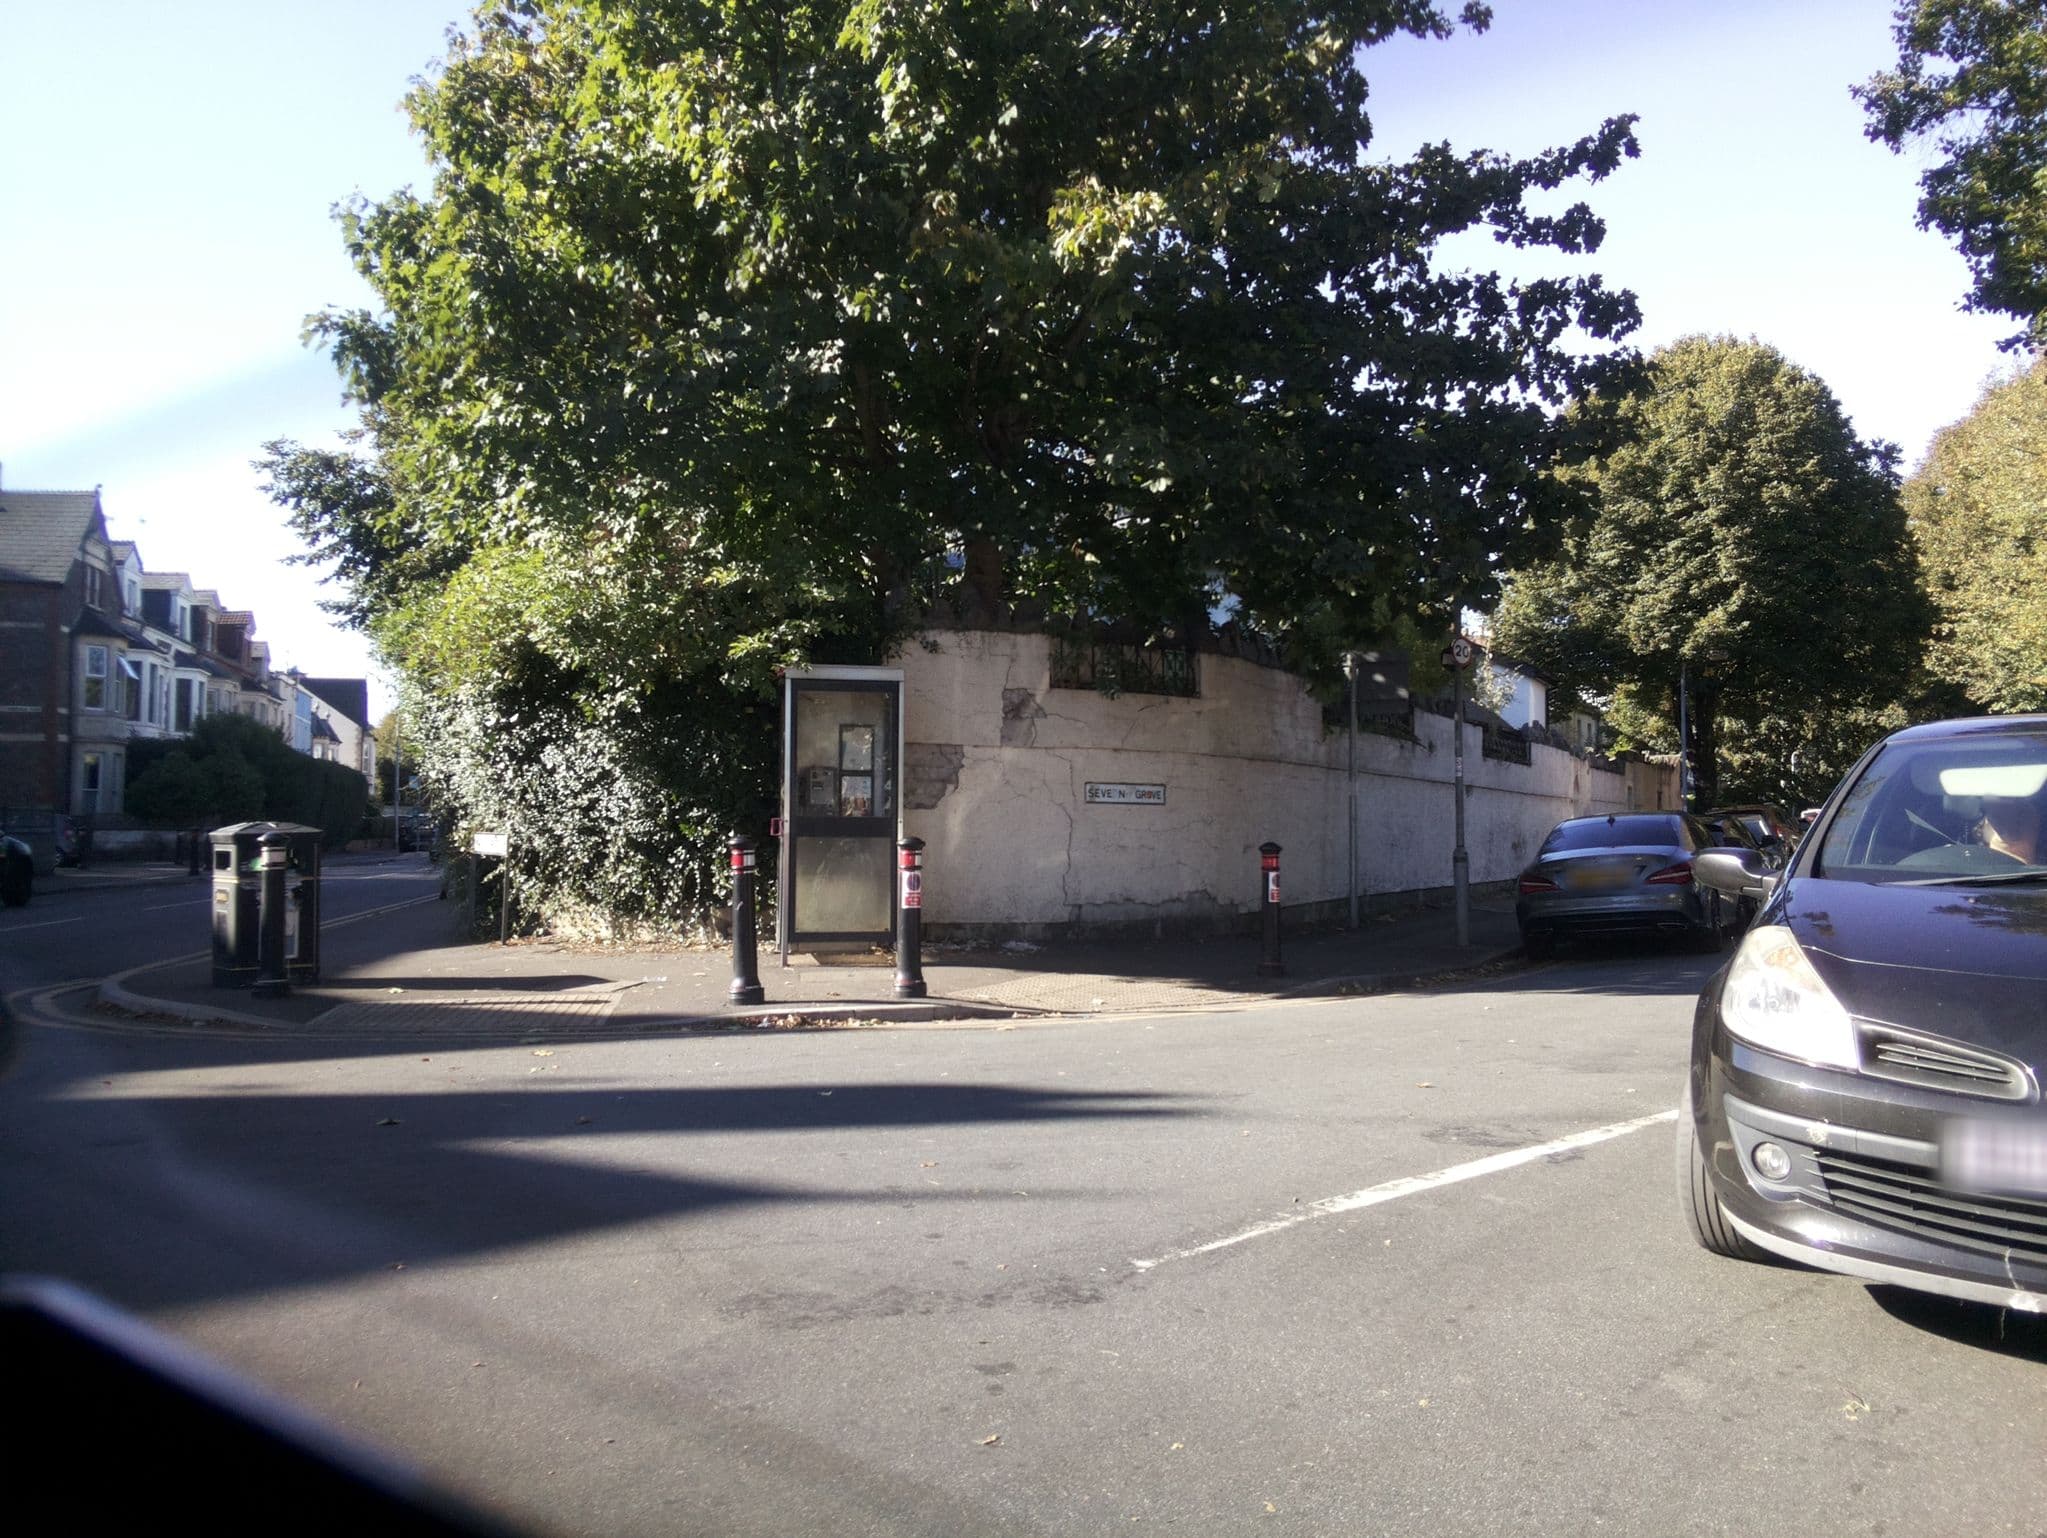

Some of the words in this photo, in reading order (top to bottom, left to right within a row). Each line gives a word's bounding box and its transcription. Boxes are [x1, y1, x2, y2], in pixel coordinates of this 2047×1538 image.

[1455, 645, 1469, 658] 20
[1088, 788, 1126, 799] SEVEN
[1135, 790, 1162, 800] GROVE
